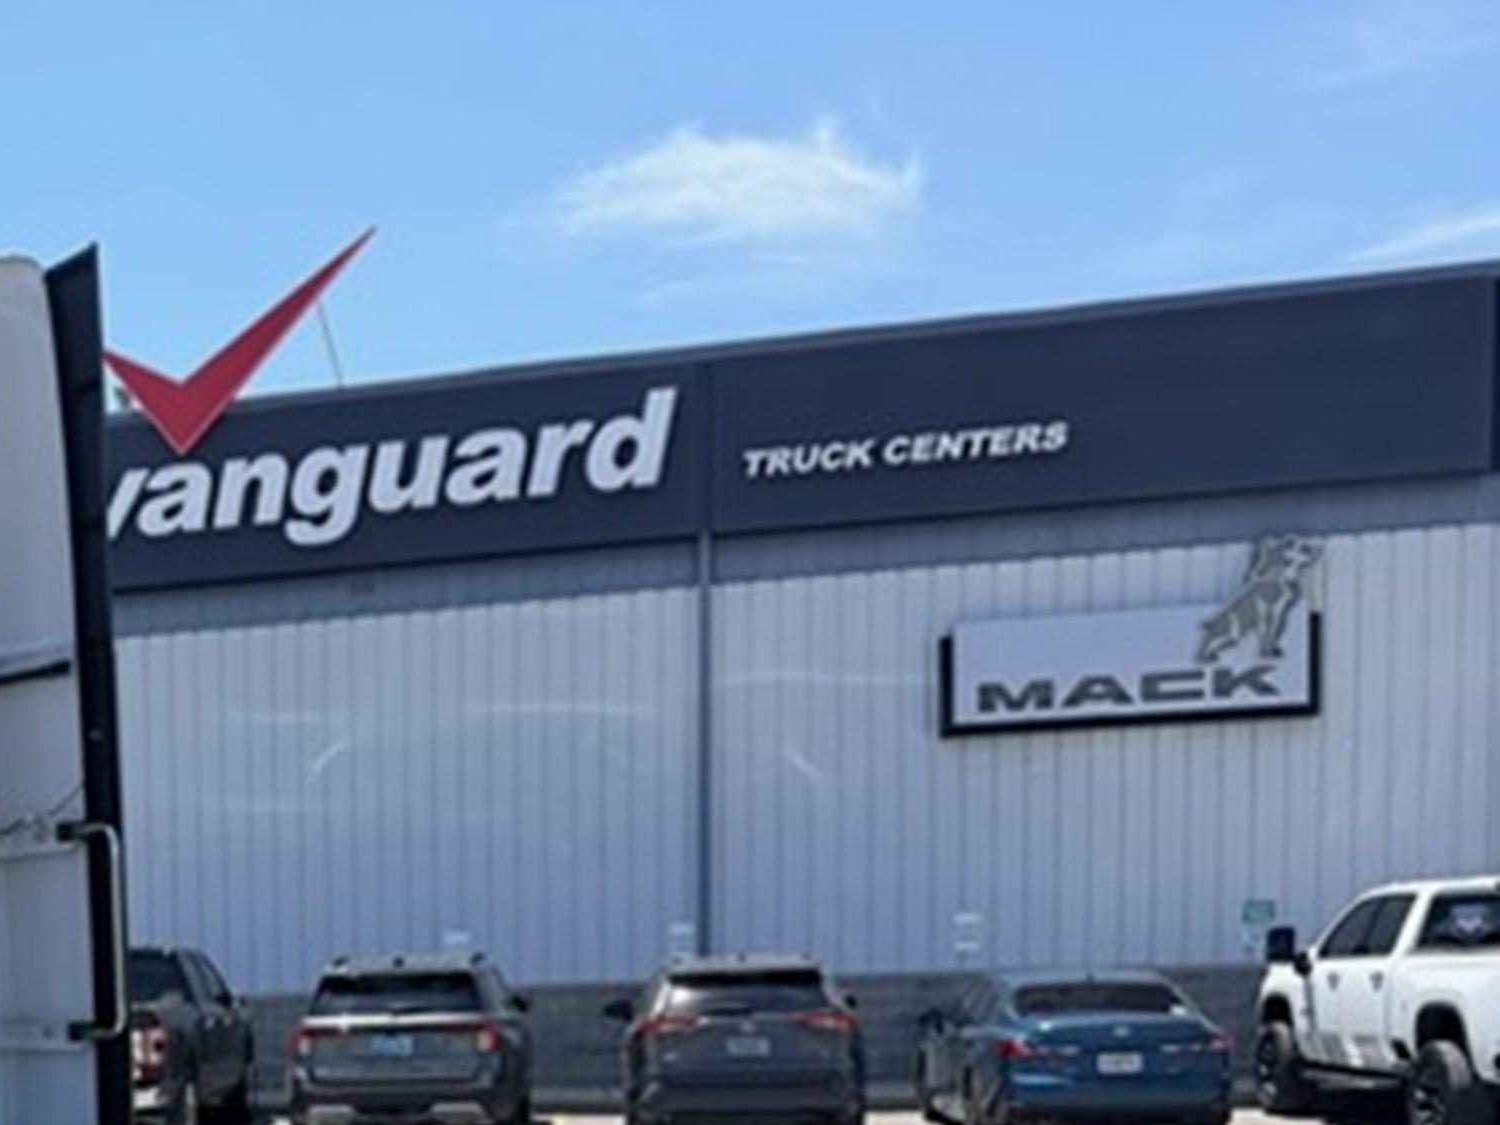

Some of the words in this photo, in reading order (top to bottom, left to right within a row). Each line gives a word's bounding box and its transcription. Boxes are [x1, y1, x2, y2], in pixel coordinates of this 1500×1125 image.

[743, 438, 876, 477] TRUCK
[883, 421, 1068, 465] CENTERS
[977, 664, 1279, 713] MACK
